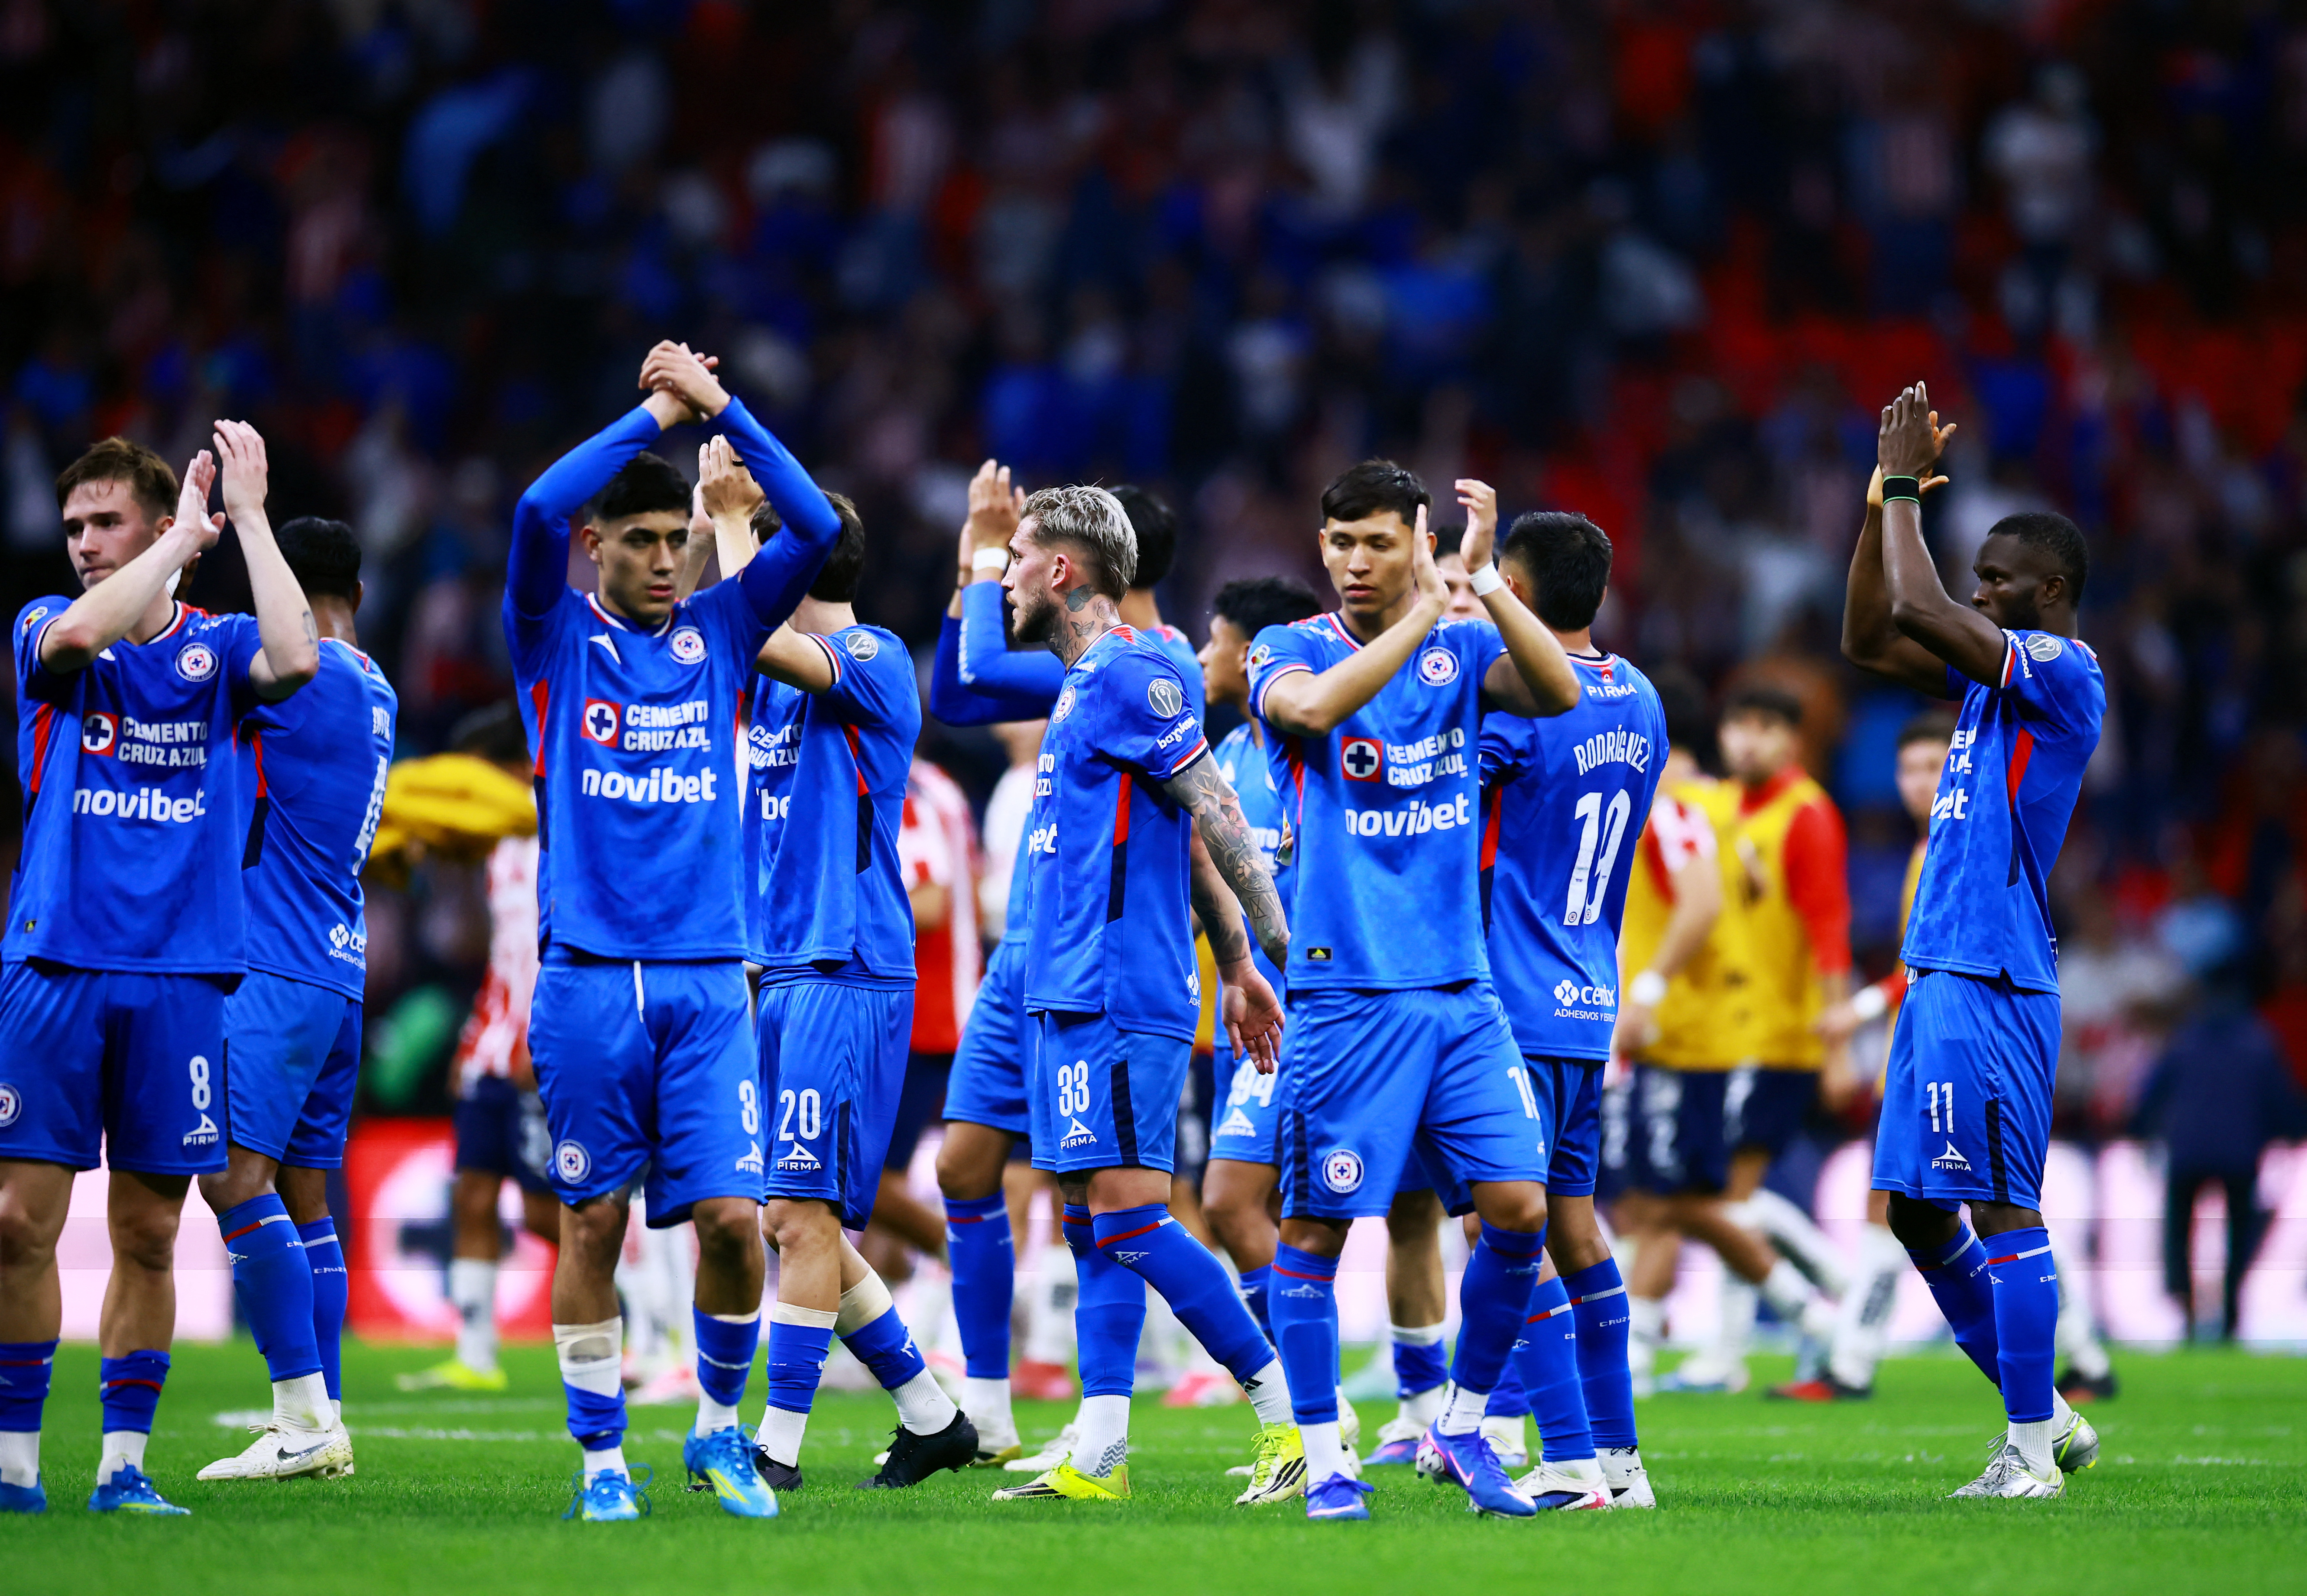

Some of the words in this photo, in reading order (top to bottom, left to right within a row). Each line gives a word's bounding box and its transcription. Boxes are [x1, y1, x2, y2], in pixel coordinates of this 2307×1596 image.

[1586, 683, 1638, 697] PIRMA
[118, 741, 167, 765] CRUZ
[624, 730, 675, 751] CRUZ
[1573, 724, 1650, 776] RODRÍGUEZ
[766, 747, 800, 767] AZU
[582, 766, 717, 803] novibet
[1388, 763, 1434, 786] CRUZ
[73, 787, 206, 823] novibet
[1345, 792, 1470, 837] novibet
[1562, 788, 1631, 926] 19
[1554, 1008, 1599, 1021] ADHESIVOS
[1600, 1013, 1604, 1021] Y
[189, 1055, 211, 1110] 8
[1057, 1060, 1090, 1117] 33
[779, 1088, 820, 1141] 20
[1927, 1082, 1954, 1133] 11
[1060, 1134, 1098, 1150] PIRMA
[777, 1161, 822, 1171] PIRMA
[1932, 1161, 1972, 1172] PIRMA
